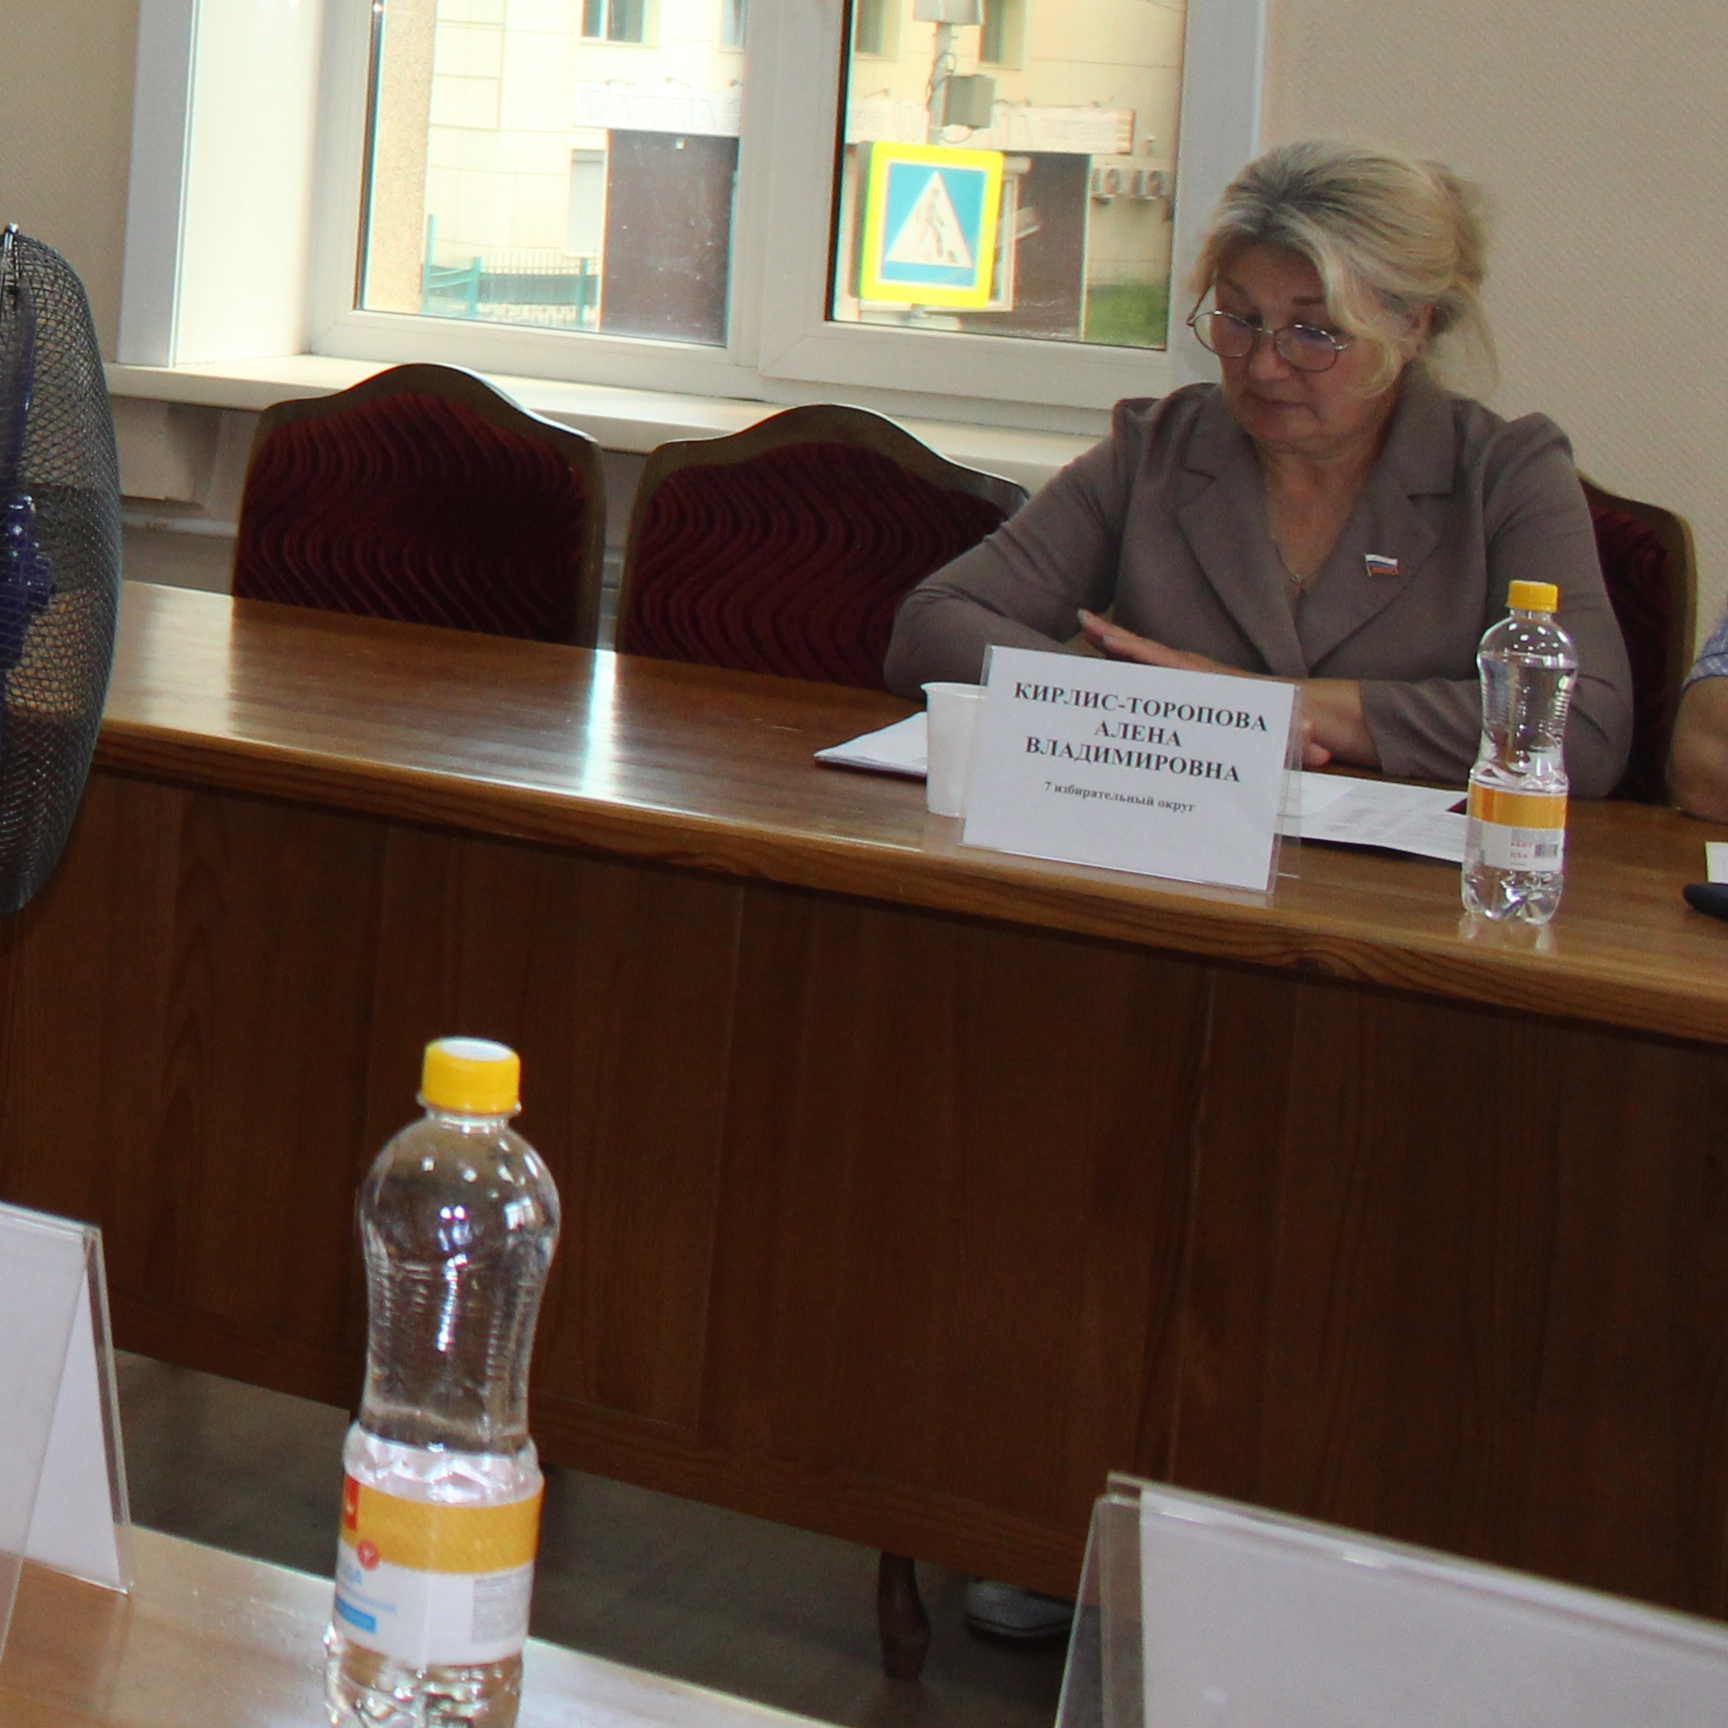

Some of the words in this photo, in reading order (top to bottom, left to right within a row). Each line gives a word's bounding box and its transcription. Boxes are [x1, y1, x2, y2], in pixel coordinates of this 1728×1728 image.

[1013, 682, 1268, 732] КИРЛИС-ТОРОПОВА
[1094, 720, 1182, 747] АЛЕНА
[1025, 736, 1241, 783] ВЛАДИМИРОВНА
[1045, 781, 1052, 791] 7
[1054, 783, 1155, 807] избирательный
[1158, 798, 1196, 813] округ
